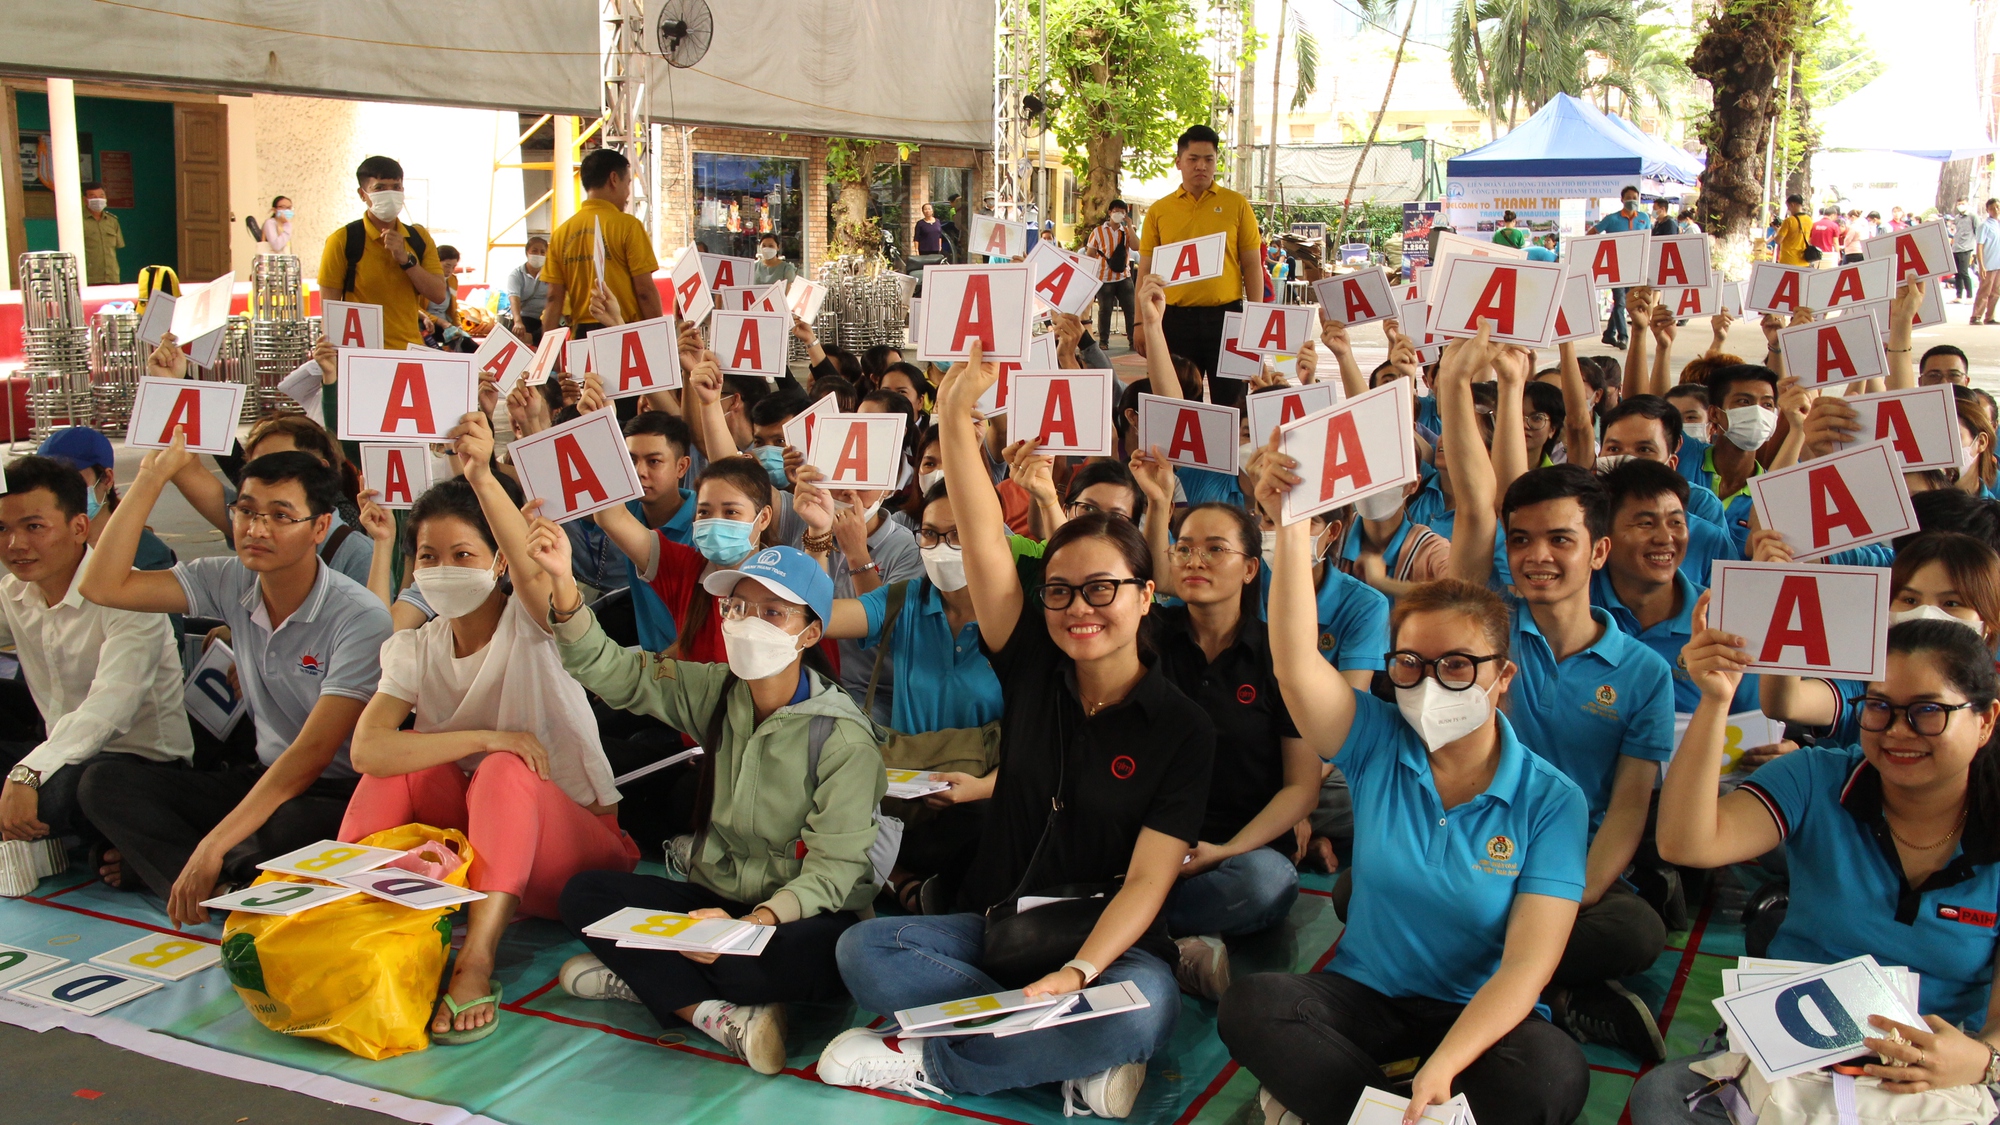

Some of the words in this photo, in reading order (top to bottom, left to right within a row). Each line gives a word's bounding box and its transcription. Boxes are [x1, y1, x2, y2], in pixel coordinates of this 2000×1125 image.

[1493, 197, 1537, 209] THANH
[986, 223, 1007, 255] A
[1592, 239, 1621, 283] A
[1895, 234, 1930, 282] A
[712, 260, 735, 290] A
[1035, 262, 1075, 306] A
[1171, 243, 1200, 281] A
[1657, 242, 1688, 285] A
[678, 272, 702, 312] A
[792, 285, 813, 315] A
[1343, 279, 1376, 322] A
[1464, 267, 1517, 335] A
[1677, 288, 1701, 316] A
[1768, 271, 1800, 312] A
[1828, 267, 1865, 307] A
[343, 308, 365, 347] A
[951, 274, 995, 352] A
[1258, 309, 1287, 350] A
[483, 341, 518, 382] A
[531, 336, 556, 380] A
[619, 331, 654, 391] A
[731, 318, 763, 370] A
[1816, 326, 1857, 383] A
[158, 388, 201, 446] A
[380, 362, 436, 434] A
[1037, 379, 1078, 446] A
[832, 422, 868, 481] A
[1168, 408, 1208, 464] A
[1875, 399, 1924, 464] A
[385, 449, 412, 503] A
[554, 433, 608, 512] A
[1320, 411, 1372, 502] A
[1808, 464, 1873, 549] A
[1758, 575, 1831, 666] A
[194, 667, 239, 717] D
[294, 847, 371, 873] B
[240, 886, 314, 907] C
[372, 878, 446, 897] D
[629, 914, 704, 938] B
[129, 940, 206, 969] B
[51, 974, 128, 1003] D
[253, 1002, 277, 1013] 1960
[1774, 977, 1866, 1051] D
